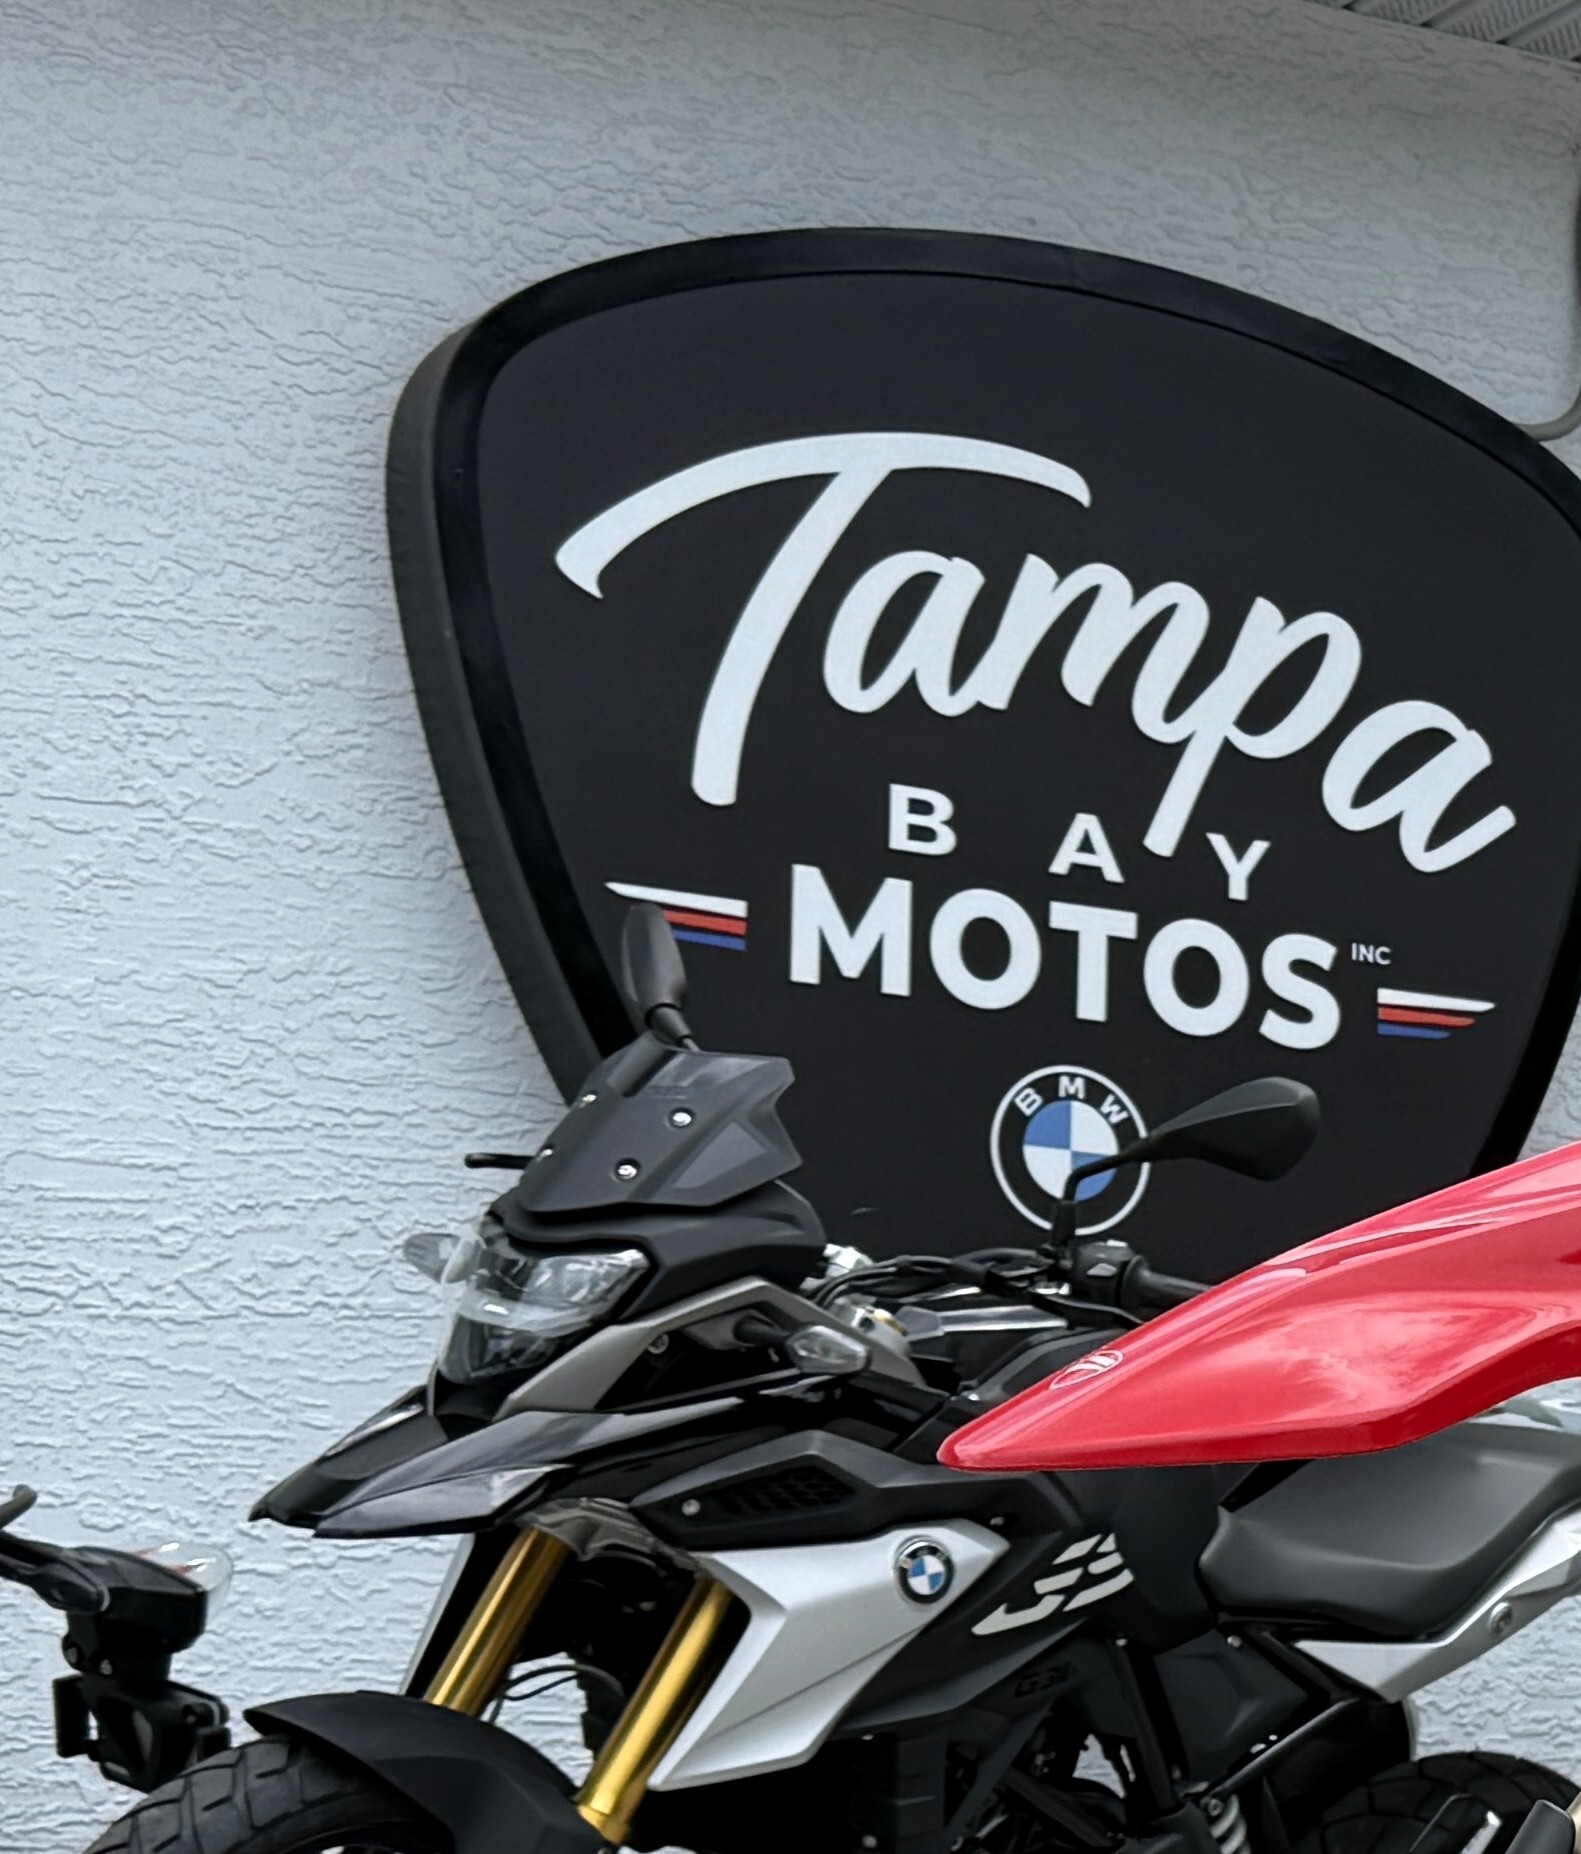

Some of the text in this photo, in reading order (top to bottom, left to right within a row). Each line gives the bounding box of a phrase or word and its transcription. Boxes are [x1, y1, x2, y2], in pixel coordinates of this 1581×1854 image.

[555, 431, 1517, 873] Tampa
[789, 863, 1391, 1050] MOTOS INC
[1013, 1075, 1129, 1124] BMW
